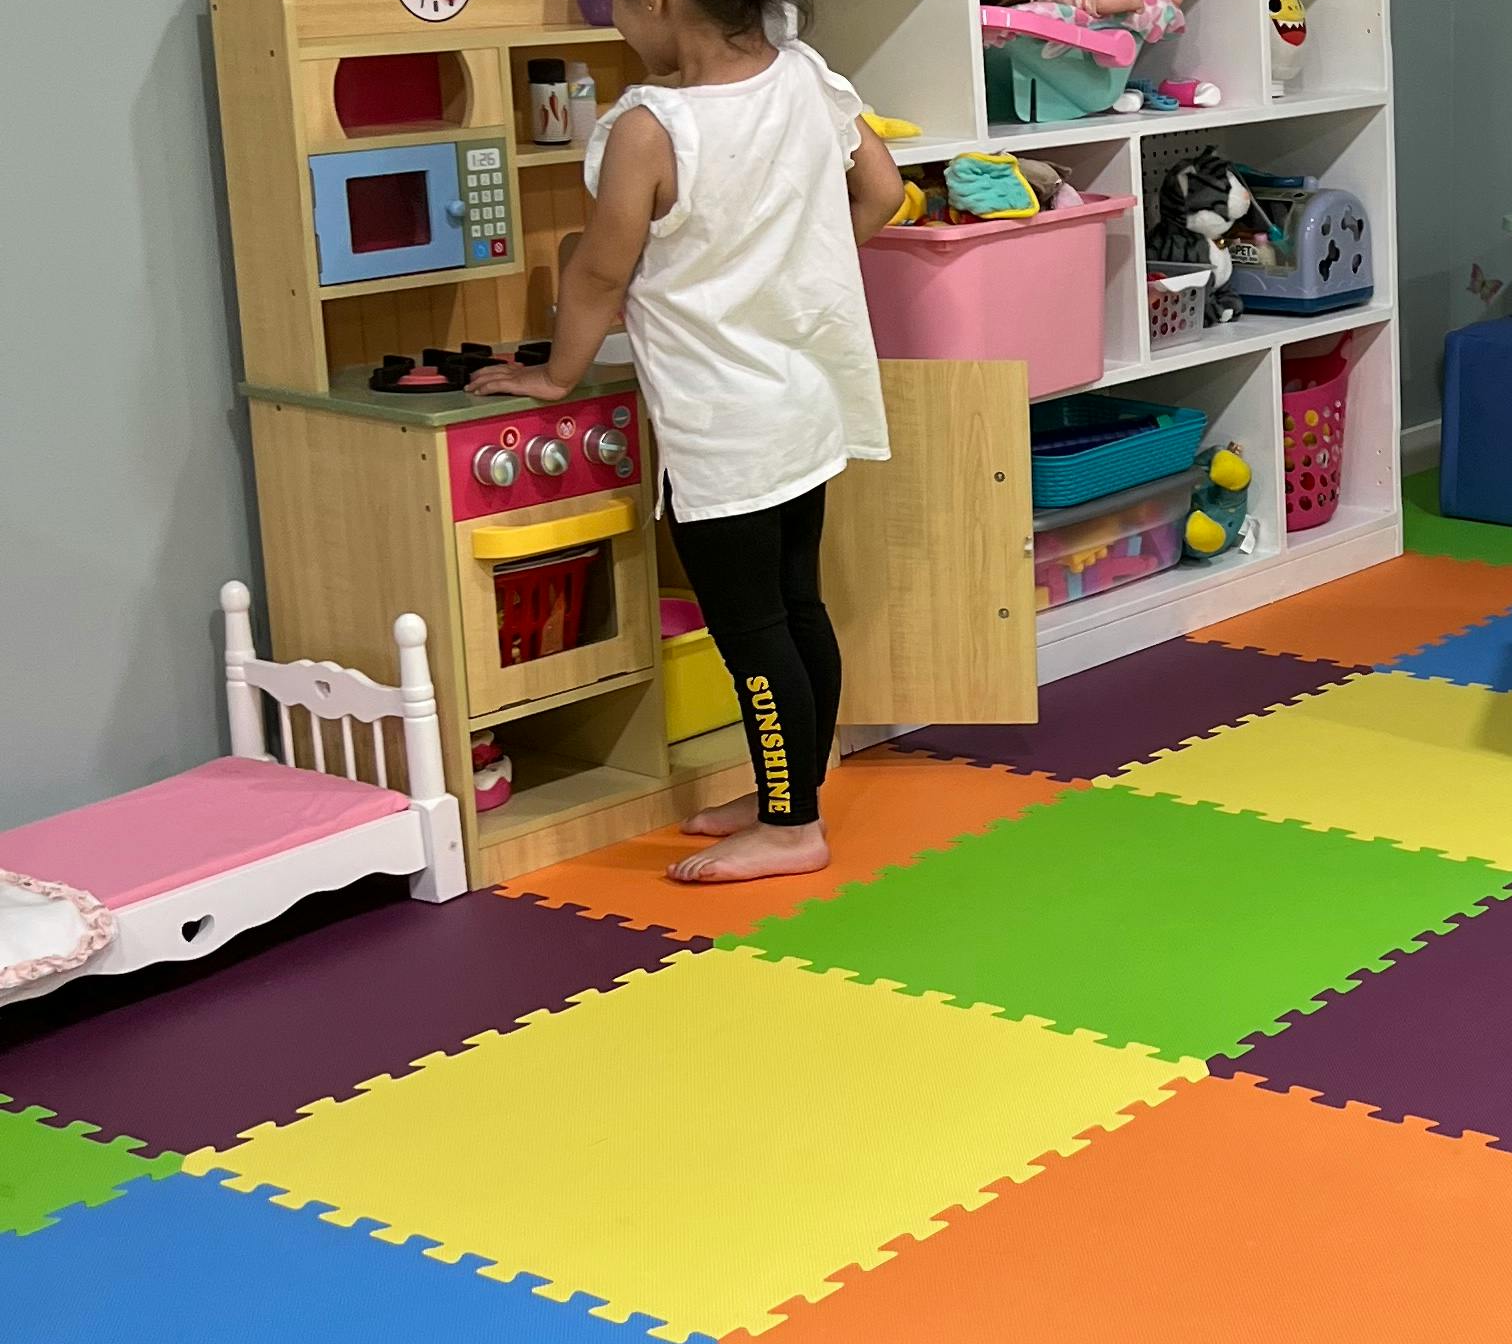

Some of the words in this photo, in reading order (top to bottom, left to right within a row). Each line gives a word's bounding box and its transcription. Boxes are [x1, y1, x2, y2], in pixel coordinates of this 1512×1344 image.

[471, 151, 498, 168] 1:26
[1235, 245, 1252, 256] PET
[746, 675, 791, 813] SUNSHINE
